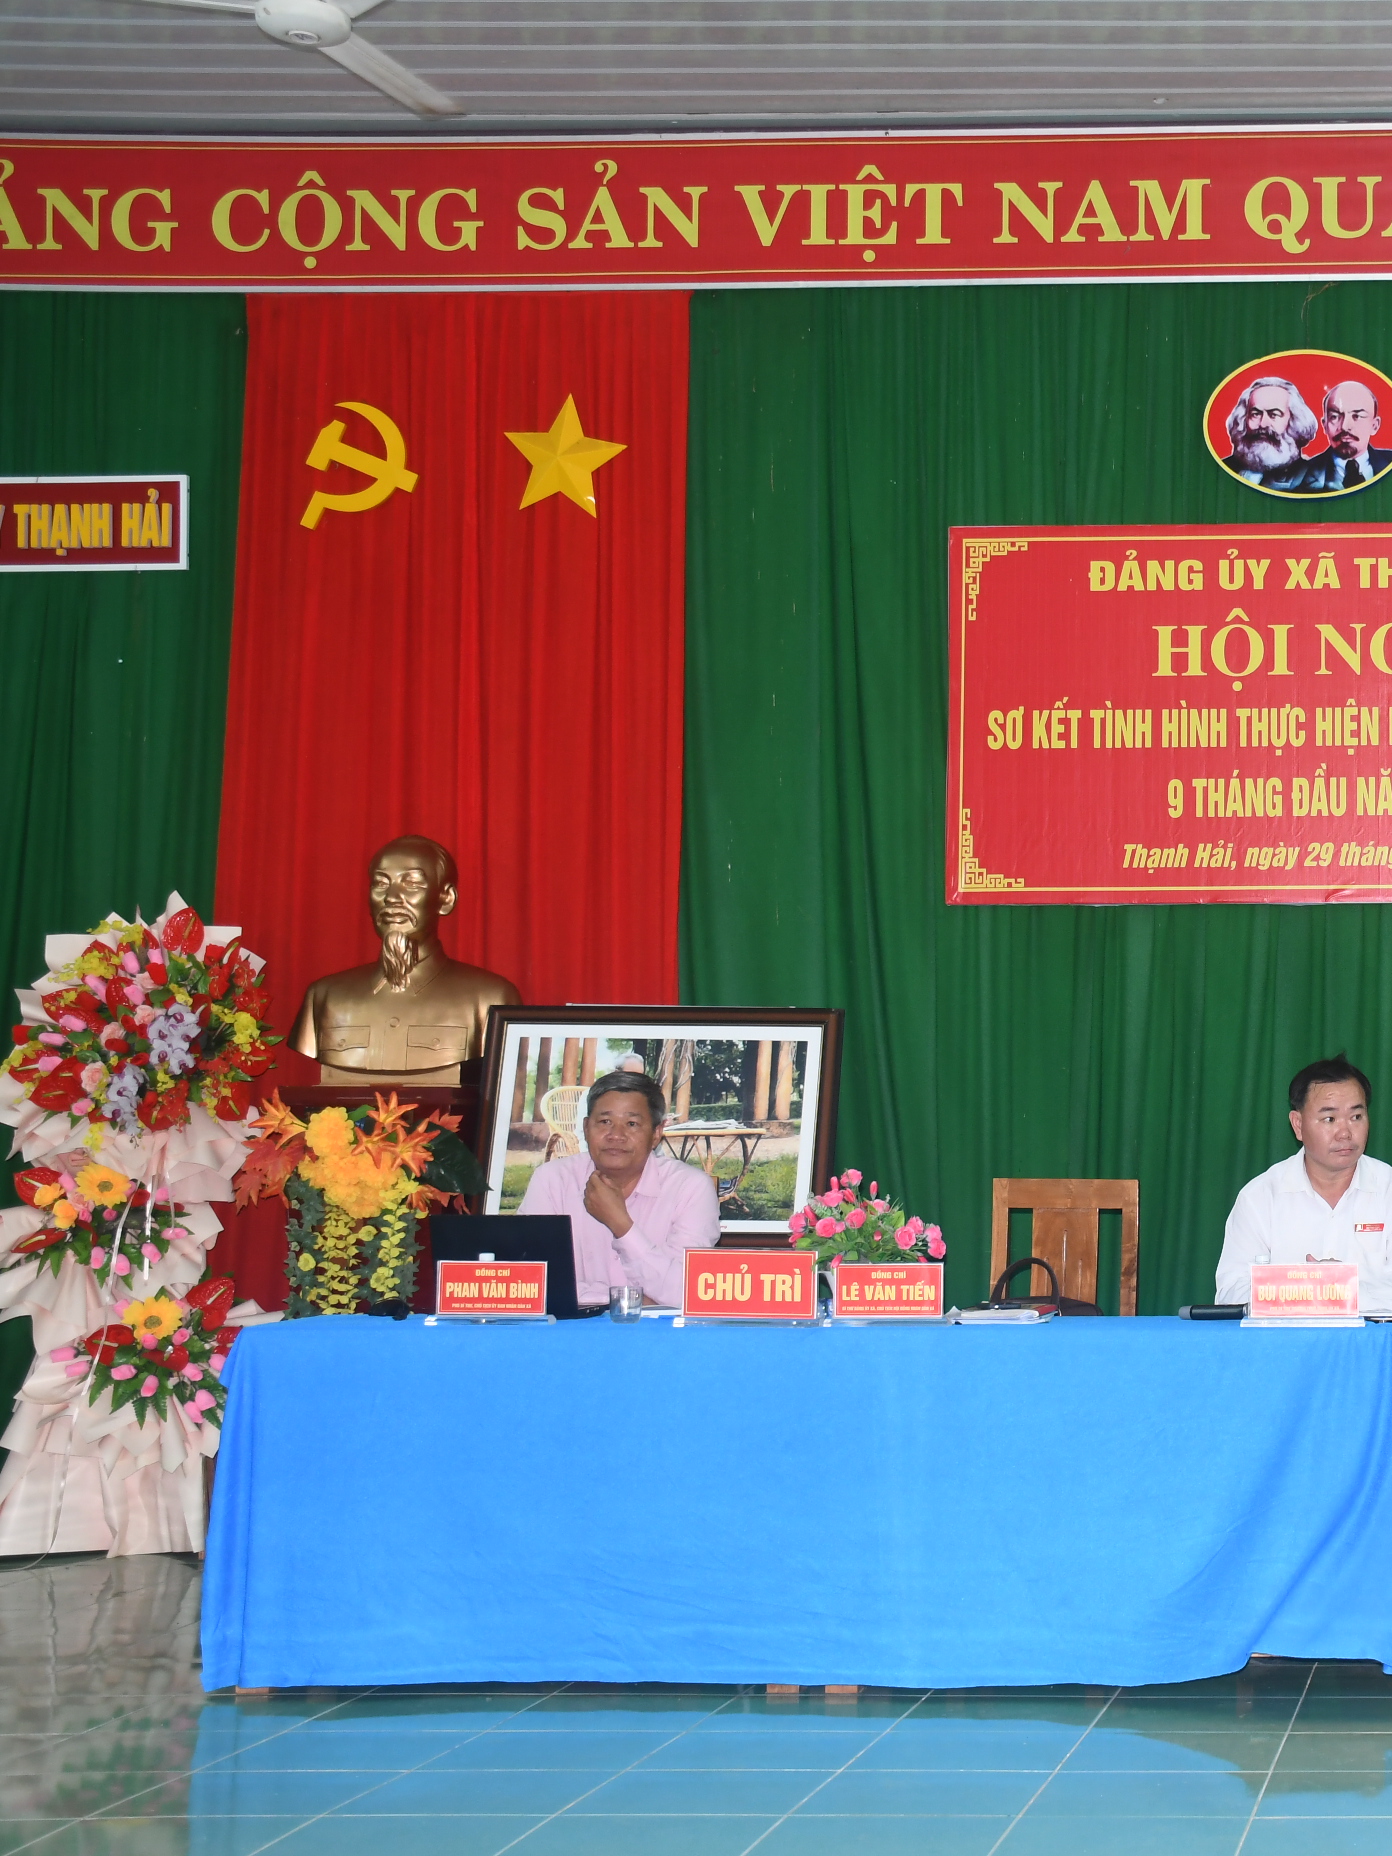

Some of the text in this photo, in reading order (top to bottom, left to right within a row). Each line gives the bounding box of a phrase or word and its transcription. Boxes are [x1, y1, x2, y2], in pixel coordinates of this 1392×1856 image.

[212, 171, 484, 268] CỘNG
[518, 160, 707, 250] SẢN
[735, 165, 962, 263] VIỆT
[993, 179, 1210, 243] NAM
[13, 503, 112, 556] THẠNH
[121, 488, 171, 547] HẢI
[1088, 549, 1204, 592] ĐẢNG
[1218, 549, 1270, 590] ỦY
[1285, 552, 1340, 589] XÃ
[1152, 608, 1294, 692] HỘI
[988, 706, 1024, 750] SƠ
[1033, 697, 1081, 749] KẾT
[1090, 701, 1151, 749] TÌNH
[1162, 700, 1226, 748] HÌNH
[1236, 703, 1305, 756] THỰC
[1316, 699, 1379, 755] HIỆN
[1168, 779, 1183, 818] 9
[1192, 770, 1283, 818] THÁNG
[1292, 767, 1347, 817] ĐẦU
[1123, 843, 1189, 874] Thạnh
[1194, 840, 1237, 870] Hải,
[1244, 842, 1300, 870] ngày
[1304, 842, 1334, 867] 29
[445, 1280, 539, 1299] PHAN VĂN BÌNH
[698, 1264, 801, 1303] CHỦ TRÌ
[842, 1280, 935, 1301] LÊ VĂN TIẾN
